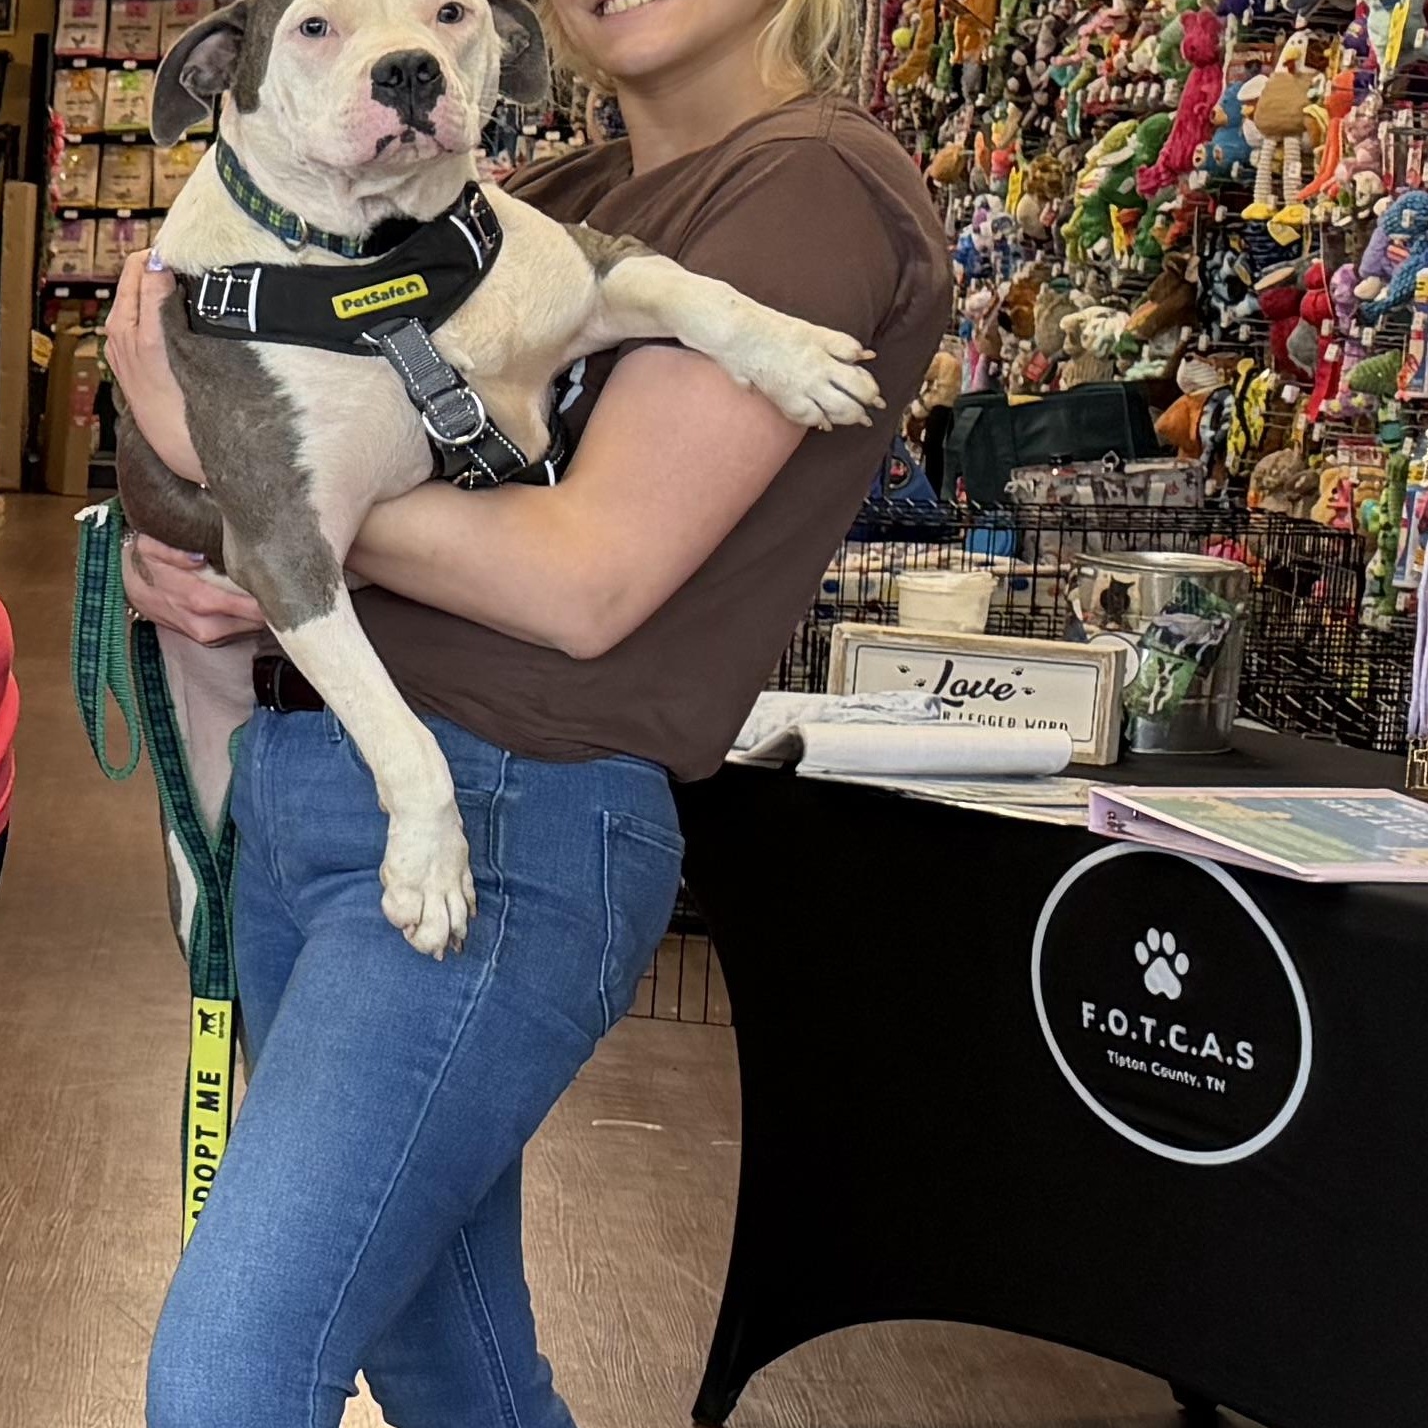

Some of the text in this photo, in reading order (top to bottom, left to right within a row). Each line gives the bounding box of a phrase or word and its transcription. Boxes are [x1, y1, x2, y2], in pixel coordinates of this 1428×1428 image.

[342, 286, 406, 312] PetSafe
[933, 659, 1017, 708] Love
[1082, 1001, 1255, 1070] F.O.T.C.A.S
[196, 1071, 221, 1112] ME
[1107, 1049, 1226, 1094] Tipton County, TN
